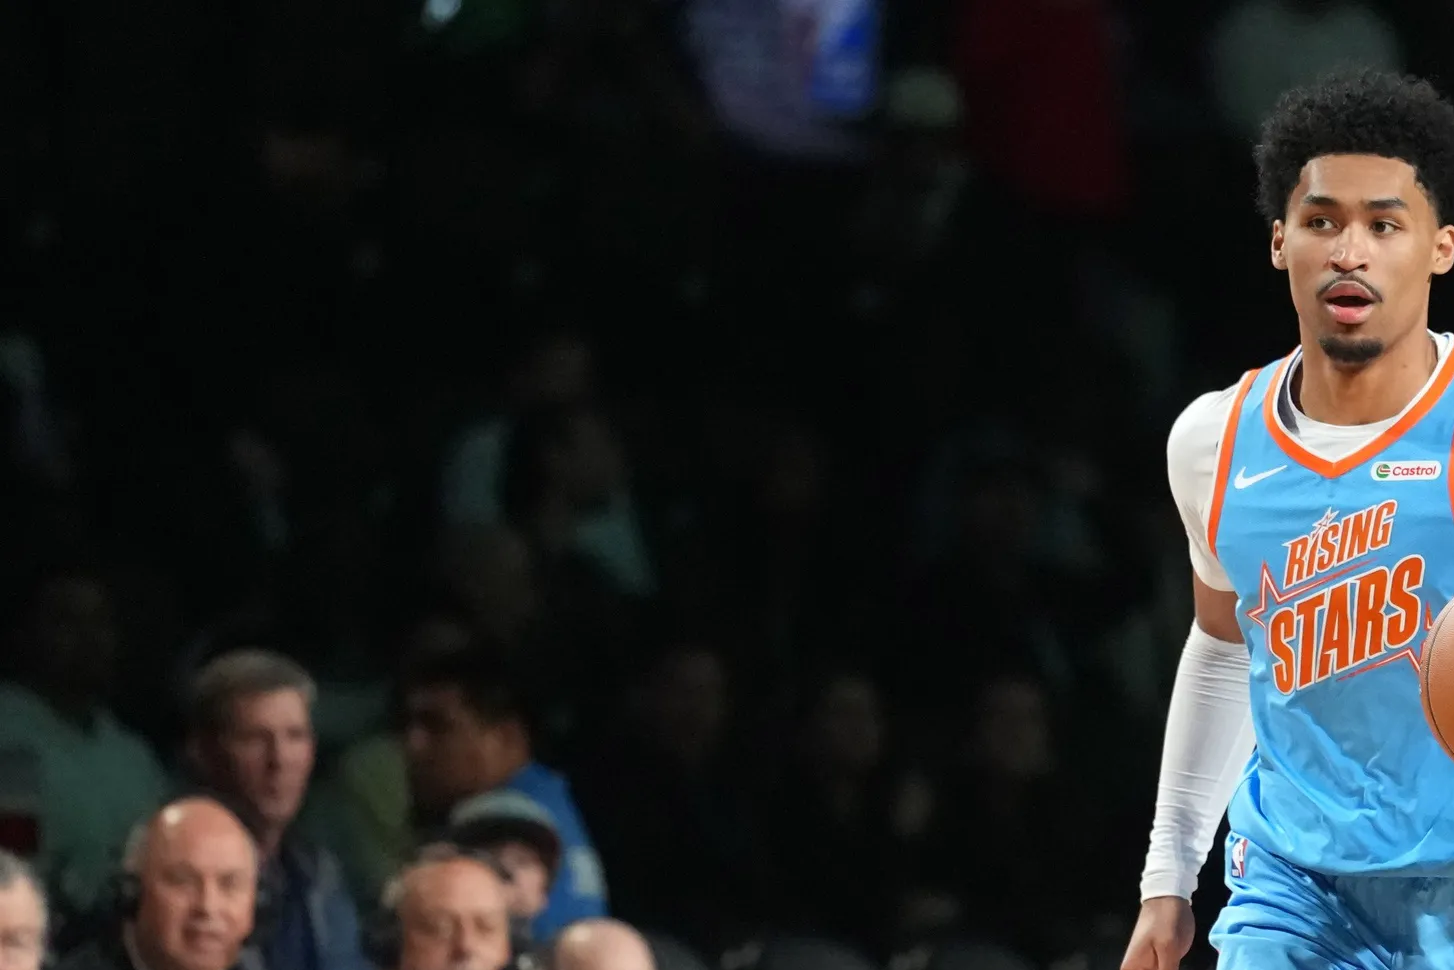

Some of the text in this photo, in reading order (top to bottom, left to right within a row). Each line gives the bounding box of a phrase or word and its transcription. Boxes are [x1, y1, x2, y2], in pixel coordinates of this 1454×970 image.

[1392, 465, 1437, 476] Castrol
[1281, 499, 1398, 589] RISING
[1268, 554, 1426, 695] STARS
